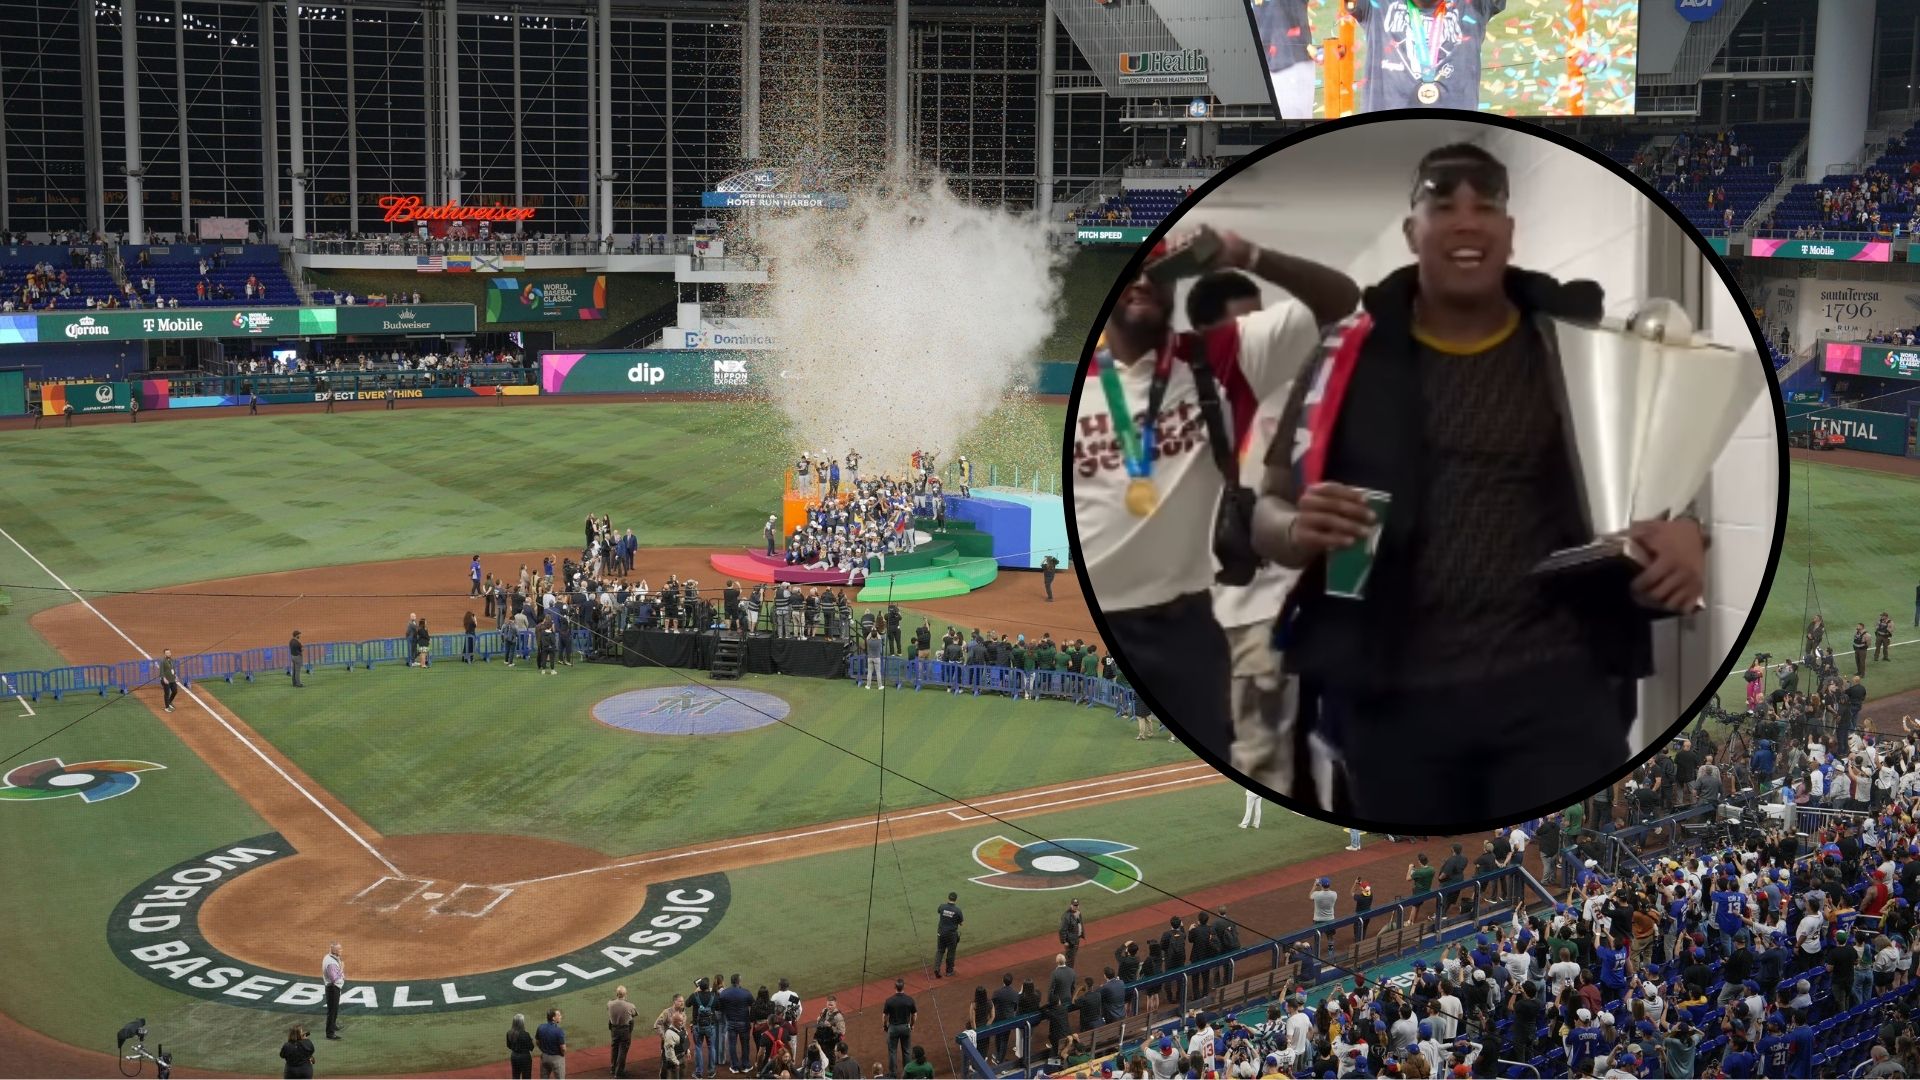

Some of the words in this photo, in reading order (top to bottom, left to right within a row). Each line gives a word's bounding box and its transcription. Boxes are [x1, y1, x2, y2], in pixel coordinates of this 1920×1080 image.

[755, 174, 773, 182] NCL
[378, 195, 536, 223] Budweiser
[727, 199, 755, 207] HOME
[759, 199, 780, 207] RUN
[783, 199, 822, 207] HARBOR
[1078, 231, 1098, 239] PITCH
[1809, 246, 1834, 255] Mobile
[543, 289, 577, 297] BASEBALL
[65, 323, 109, 339] Corona
[157, 318, 204, 332] Mobile
[383, 320, 431, 330] Budweiser
[627, 362, 665, 386] dip
[357, 389, 423, 400] EVERTHING
[128, 847, 277, 933] WORLD
[512, 888, 715, 992] CLASSIC
[130, 940, 487, 1008] BASEBALL
[1203, 1043, 1214, 1058] 13
[1585, 1041, 1590, 1055] 1
[1773, 1051, 1786, 1066] 21
